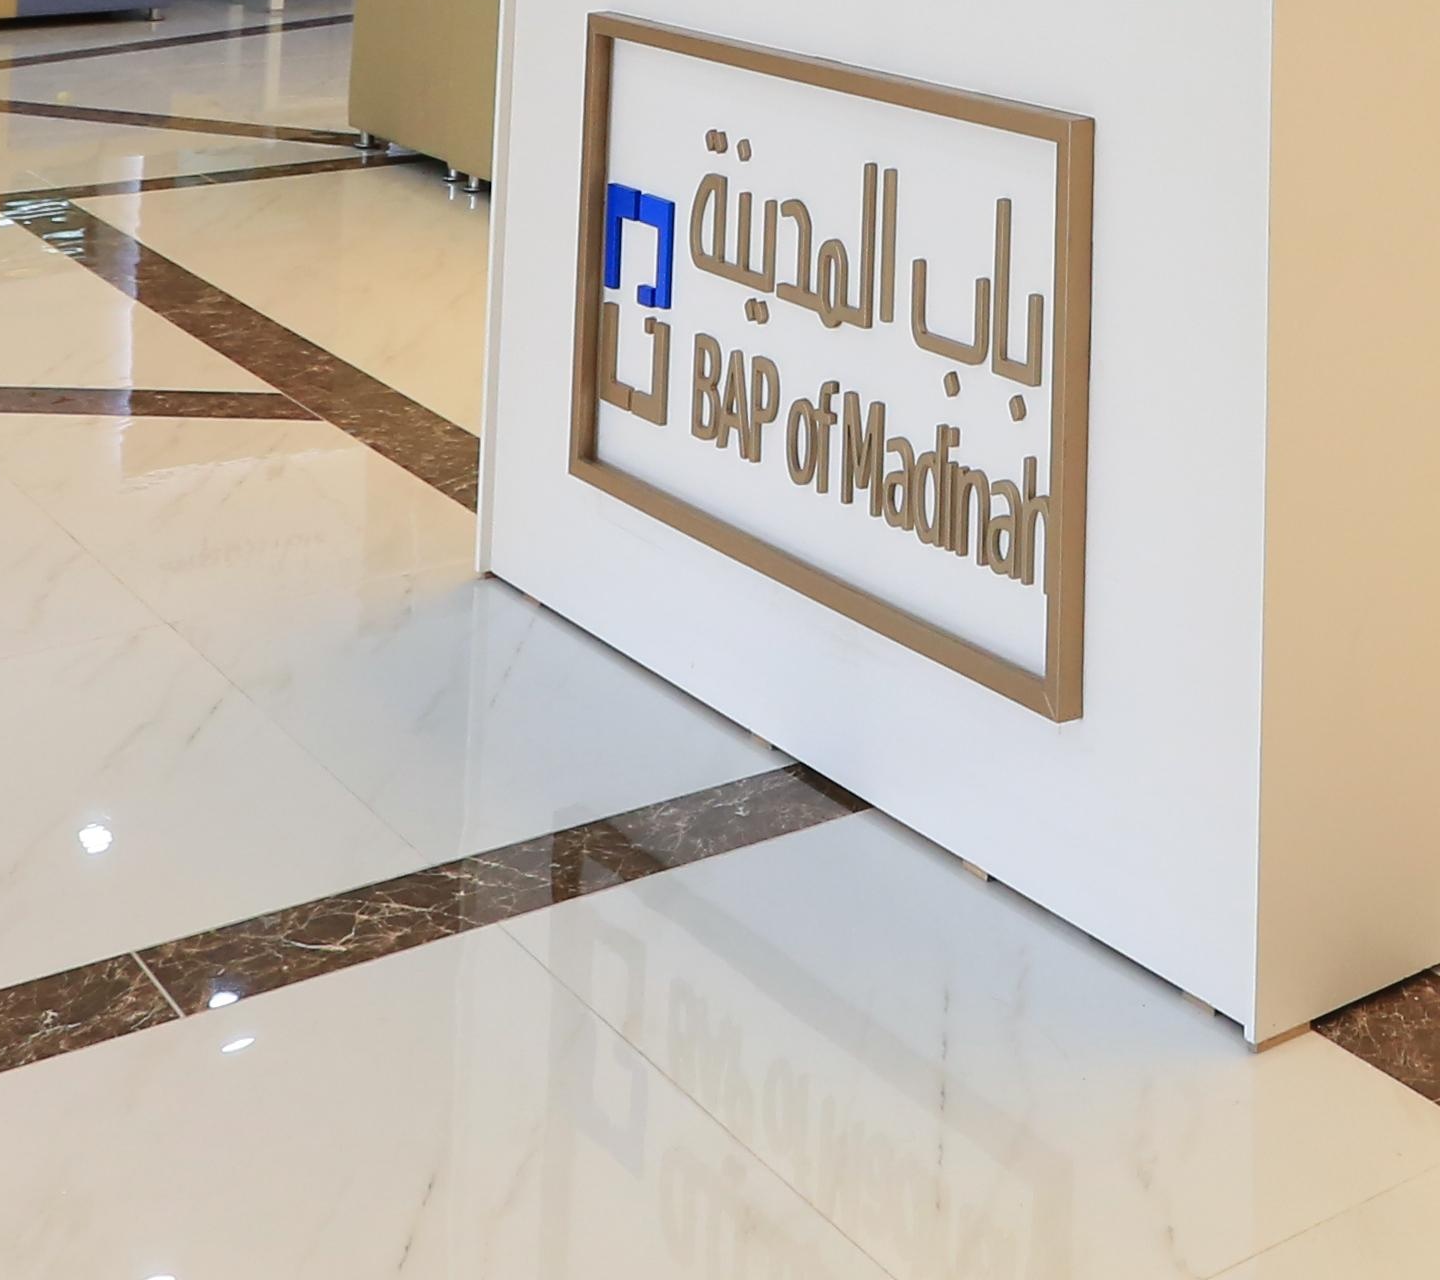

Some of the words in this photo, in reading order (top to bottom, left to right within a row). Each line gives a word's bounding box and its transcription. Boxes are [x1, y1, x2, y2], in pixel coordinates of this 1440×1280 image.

[689, 128, 899, 330] المدينة
[911, 197, 1046, 423] باب
[690, 332, 781, 463] BAP
[786, 380, 840, 495] of
[840, 390, 1051, 588] Madinah
